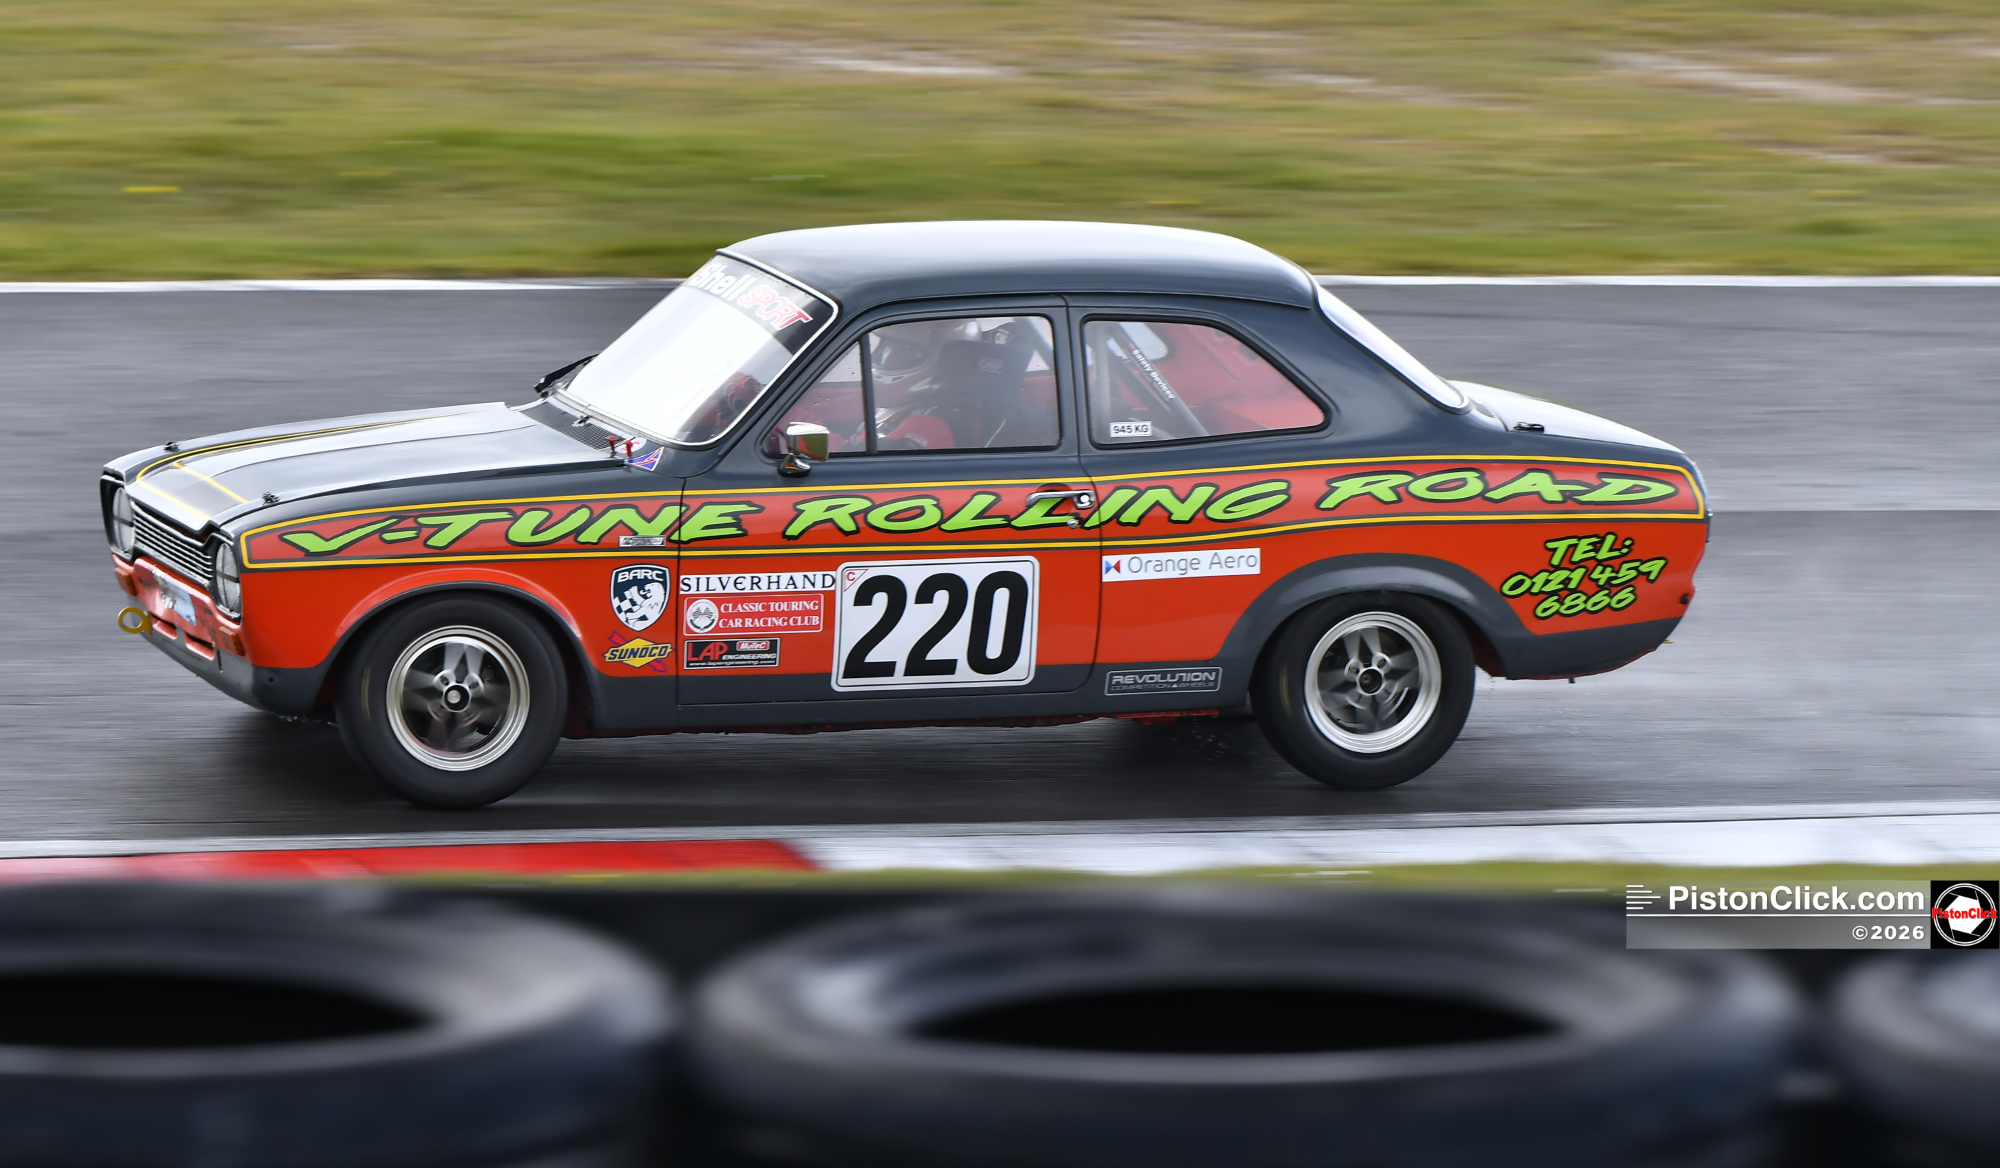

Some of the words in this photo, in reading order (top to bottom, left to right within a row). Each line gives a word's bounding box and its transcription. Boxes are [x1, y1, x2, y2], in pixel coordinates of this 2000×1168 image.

[688, 262, 757, 301] Shell
[737, 285, 814, 331] SPORT
[1132, 349, 1153, 372] Safety
[1112, 424, 1133, 434] 945
[1134, 424, 1149, 433] KG
[281, 502, 764, 556] V-TUNE
[783, 480, 1291, 540] ROLLING
[1318, 468, 1679, 509] ROAD
[1544, 532, 1635, 567] TEL:
[1127, 556, 1201, 575] Orange
[1208, 552, 1258, 569] Aero
[617, 569, 664, 582] BARC
[680, 573, 836, 592] SILVERHAND
[846, 571, 856, 582] C
[1500, 565, 1588, 598] 0121
[1588, 556, 1669, 587] 459
[720, 602, 767, 613] CLASSIC
[768, 600, 819, 612] TOURING
[1533, 585, 1637, 620] 6866
[719, 618, 743, 628] CAR
[744, 617, 788, 627] RACING
[788, 615, 820, 626] CLUB
[842, 570, 1029, 679] 220
[608, 645, 668, 660] SUNOCO
[687, 641, 728, 661] LAP
[722, 653, 777, 661] ENGINEERING
[1111, 671, 1216, 685] REVOLUTION
[1111, 683, 1171, 691] COMPETITION
